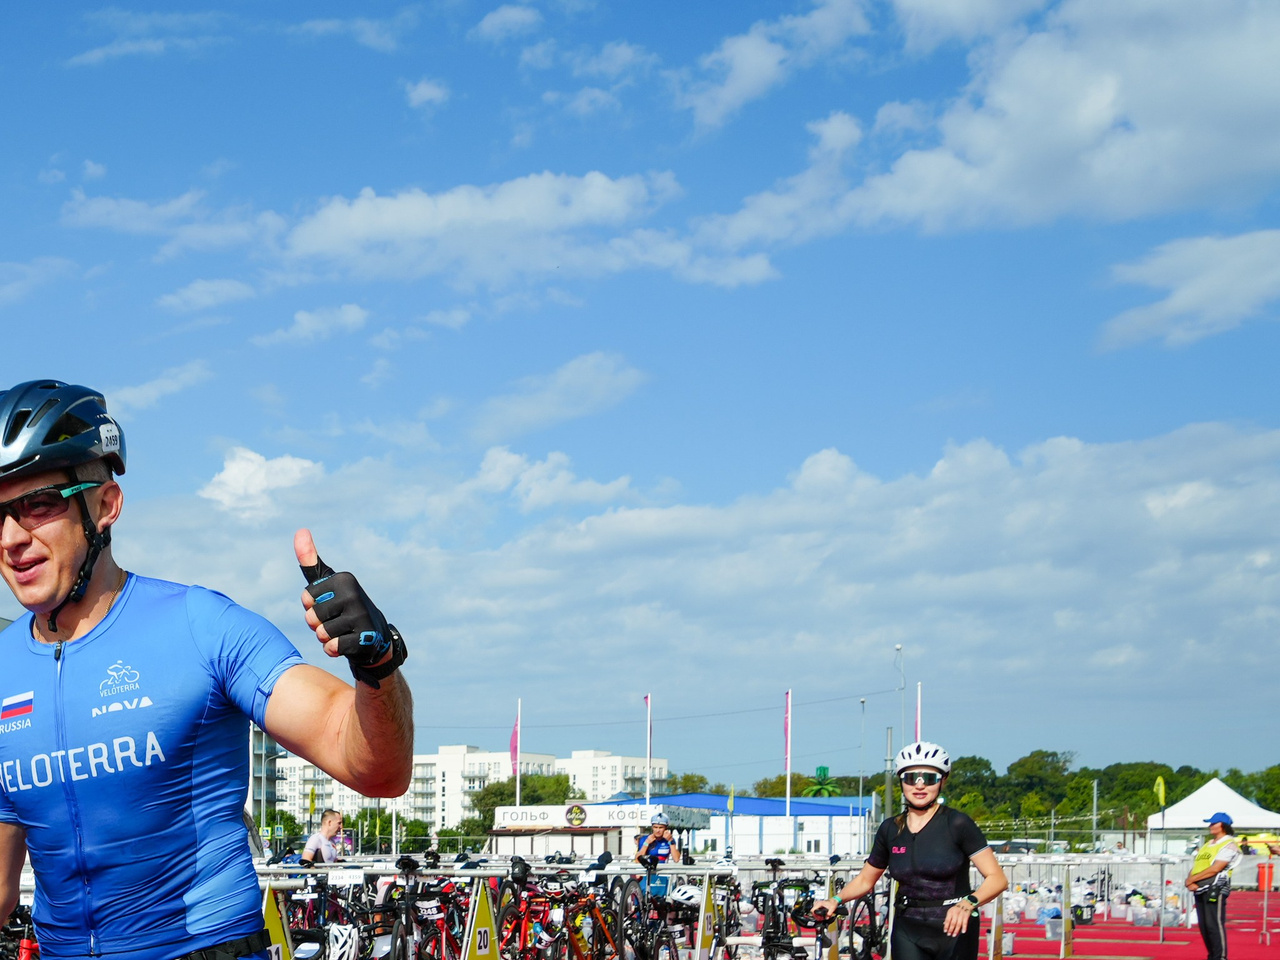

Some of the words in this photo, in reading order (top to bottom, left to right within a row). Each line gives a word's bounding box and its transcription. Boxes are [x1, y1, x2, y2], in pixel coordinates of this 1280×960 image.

[105, 434, 119, 447] 2459
[91, 696, 153, 718] NOVA
[502, 811, 549, 821] ГОЛЬФ
[607, 810, 648, 821] КОФЕ
[477, 929, 489, 950] 20
